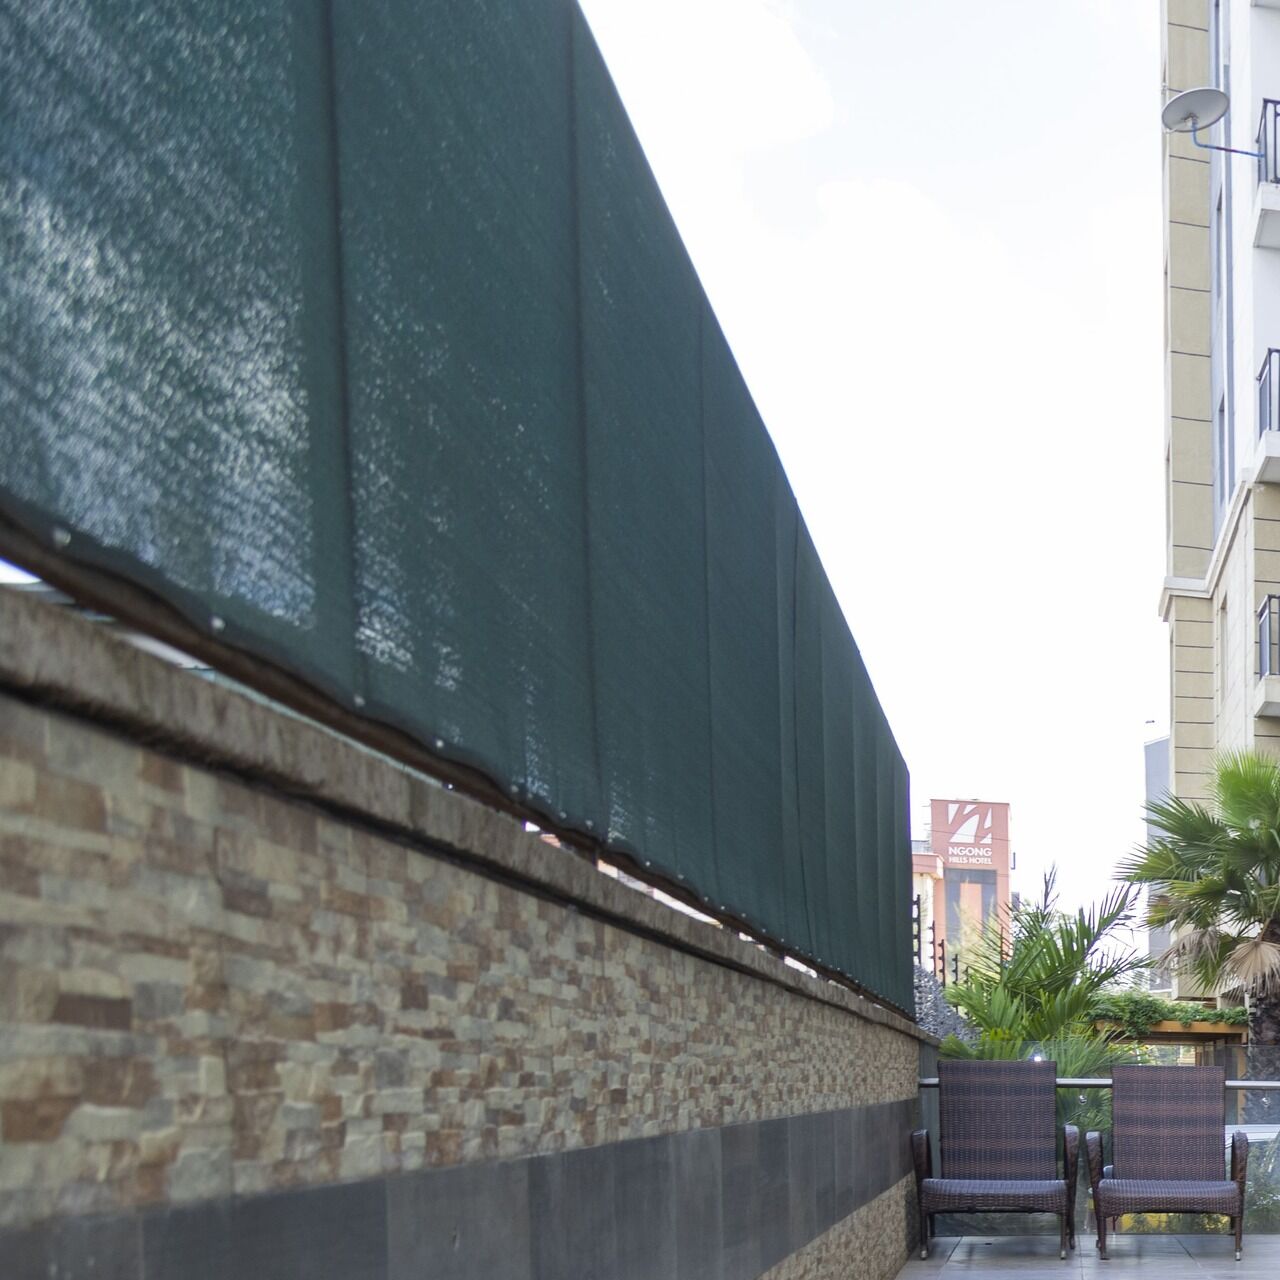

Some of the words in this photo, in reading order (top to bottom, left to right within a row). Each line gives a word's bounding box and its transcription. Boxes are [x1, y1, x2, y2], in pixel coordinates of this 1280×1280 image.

[948, 846, 992, 856] NGONG
[948, 856, 968, 864] HILLS
[969, 856, 992, 865] HOTEL
